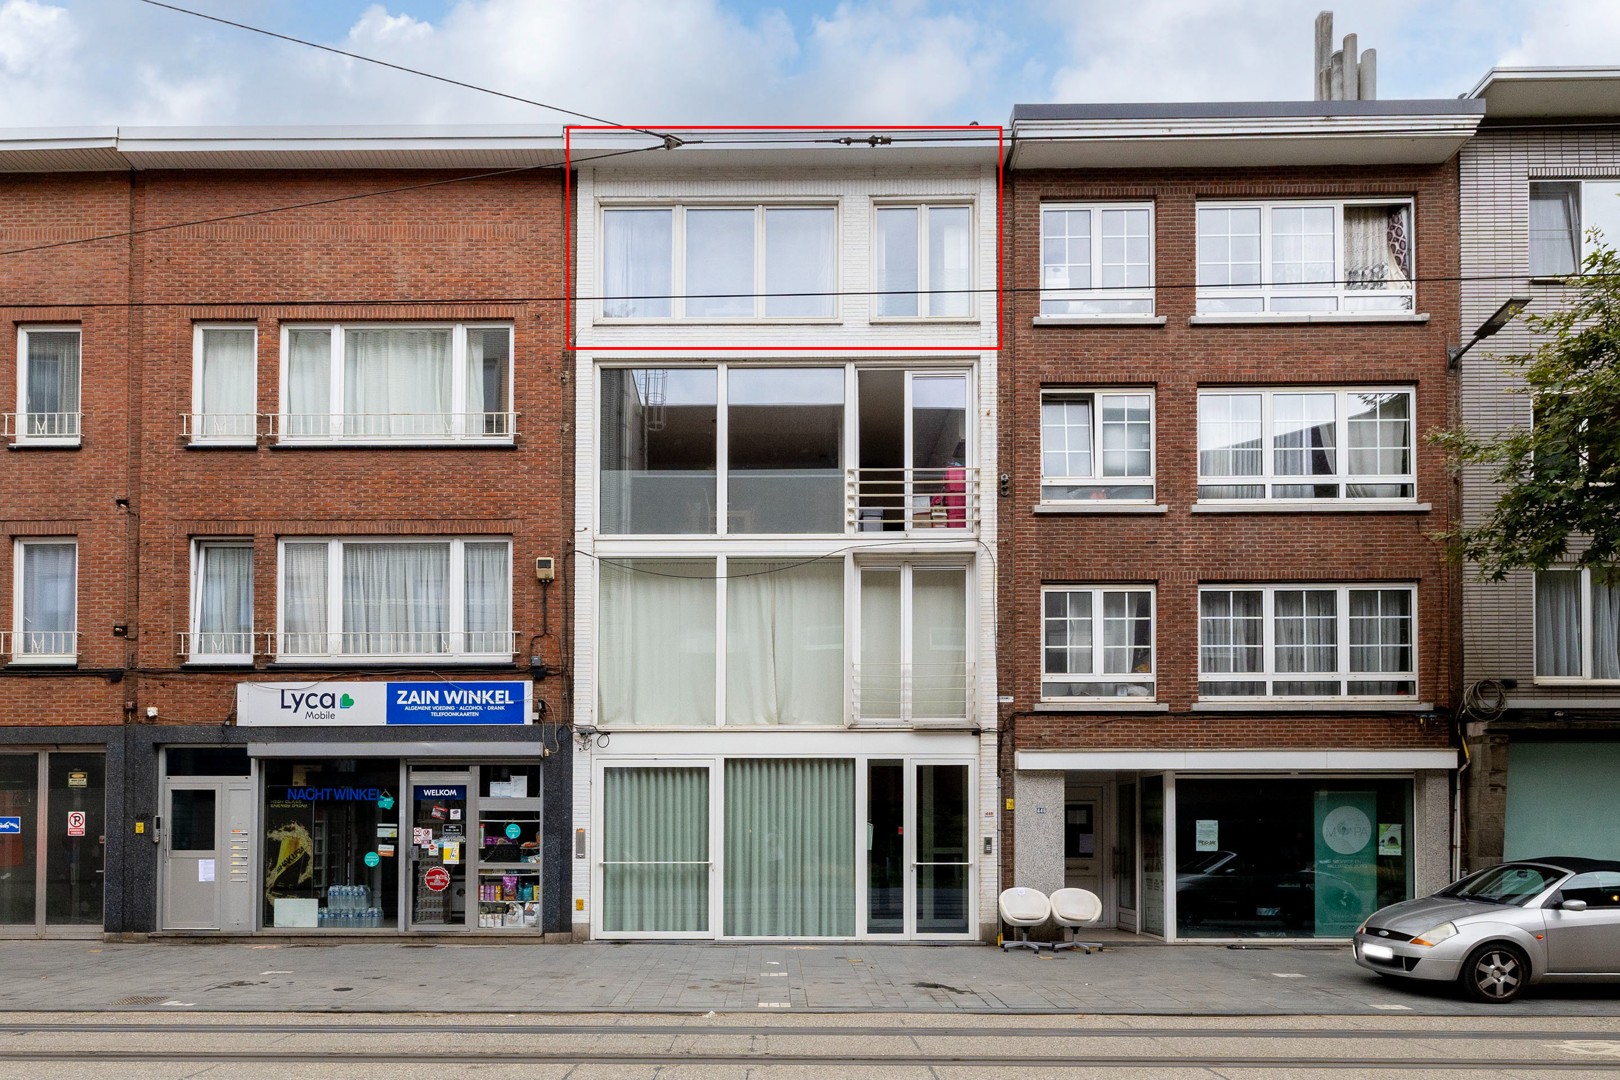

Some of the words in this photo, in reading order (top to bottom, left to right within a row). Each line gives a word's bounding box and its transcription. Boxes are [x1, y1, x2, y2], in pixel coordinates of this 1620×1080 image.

[281, 689, 336, 713] Lyca
[396, 690, 439, 705] ZAIN
[443, 690, 514, 705] WINKEL
[304, 711, 336, 720] Mobile
[423, 789, 457, 797] WELKOM
